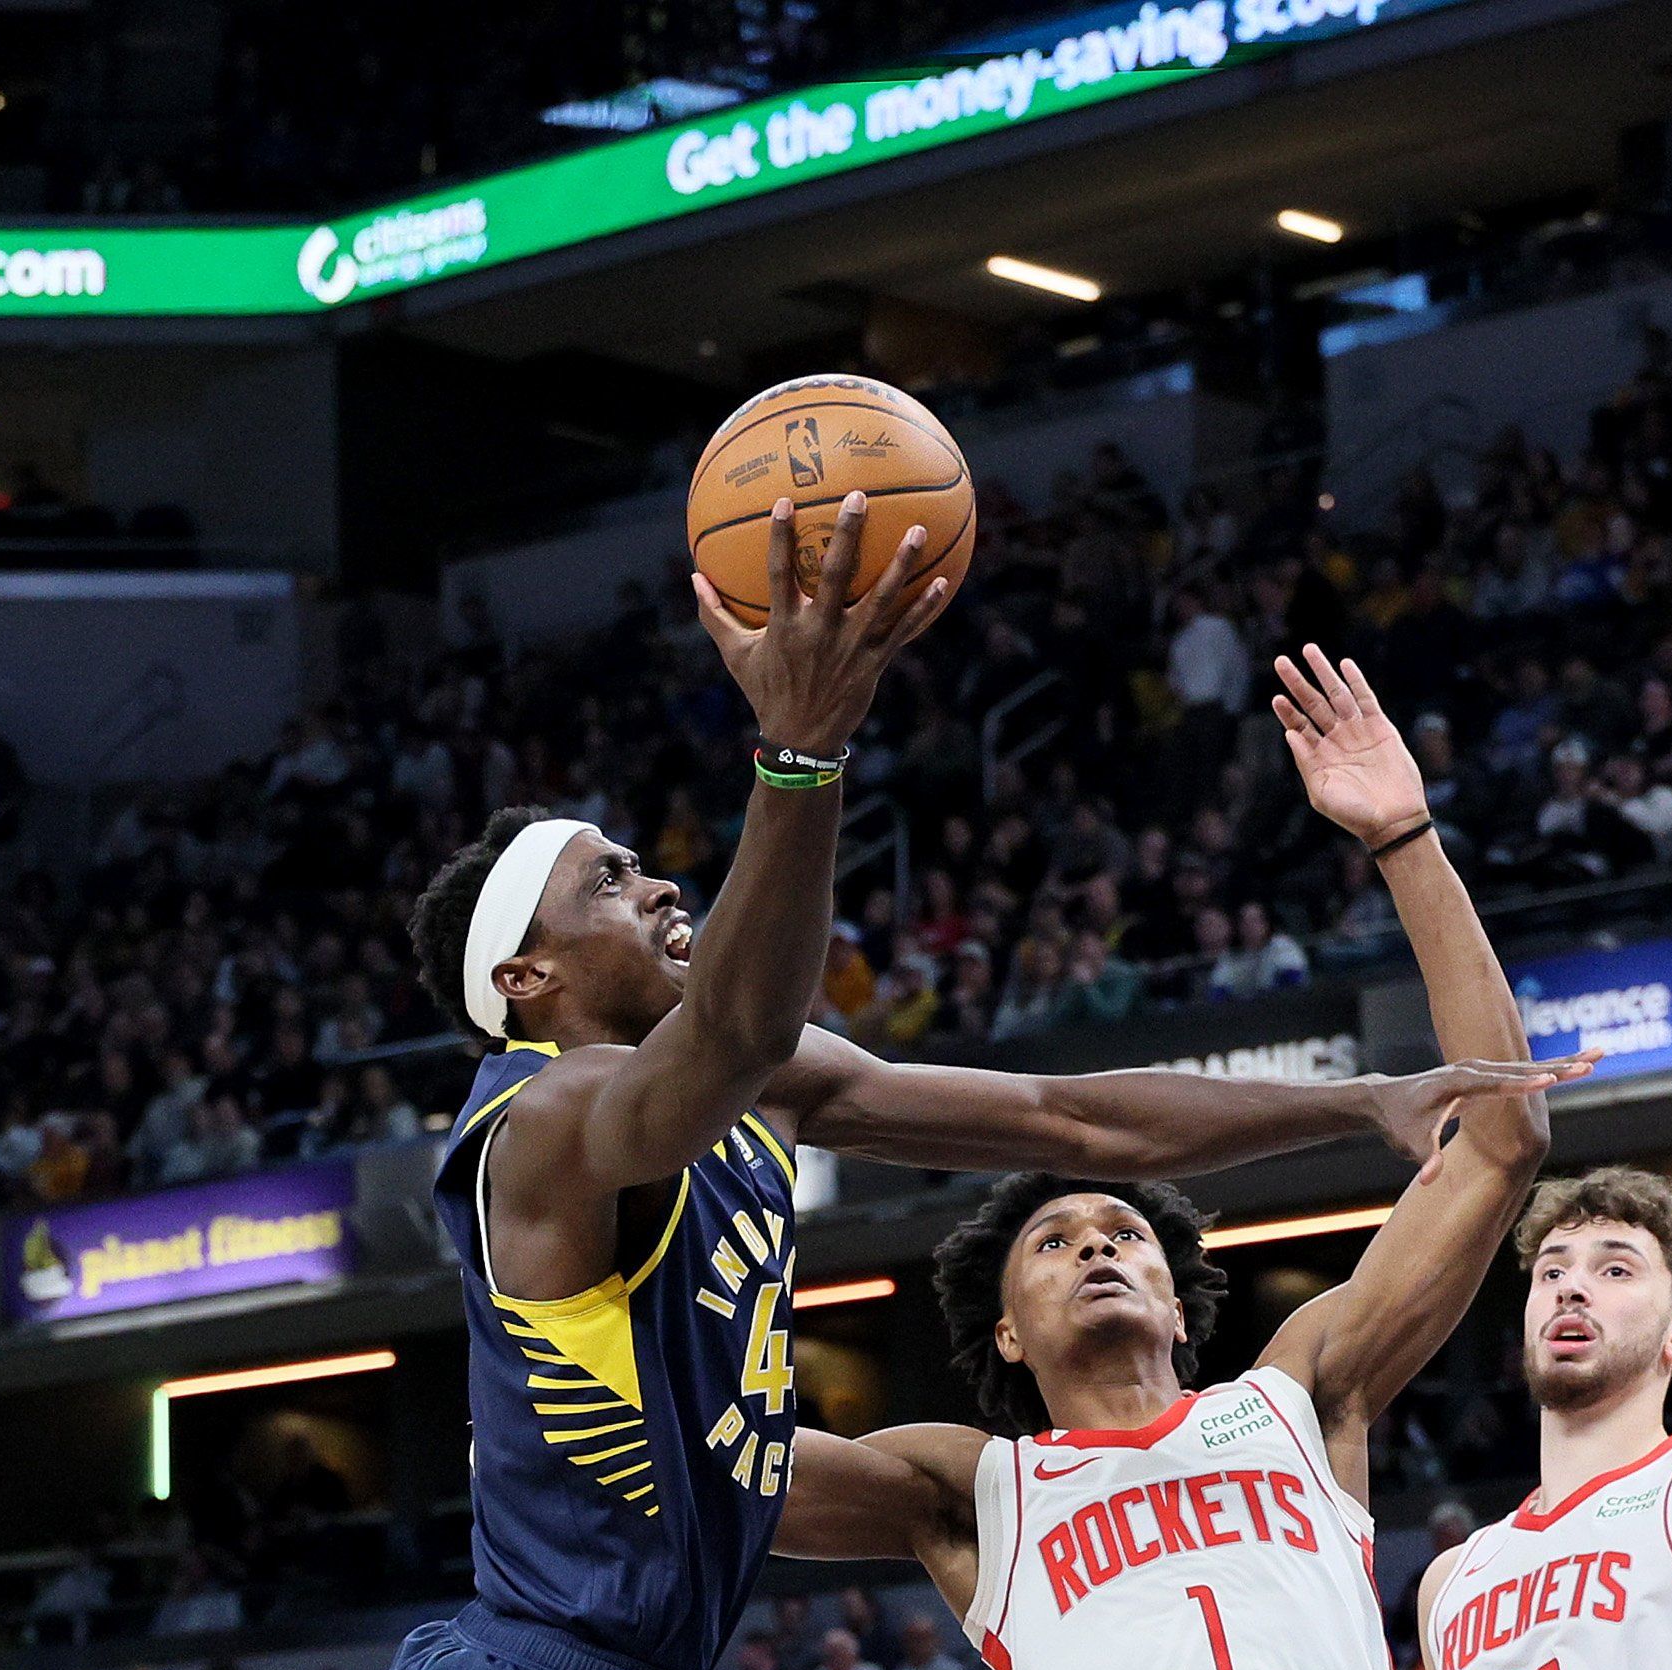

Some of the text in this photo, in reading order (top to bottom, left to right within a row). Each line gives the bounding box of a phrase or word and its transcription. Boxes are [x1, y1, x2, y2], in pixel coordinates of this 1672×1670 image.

[665, 115, 760, 195] Get
[768, 92, 856, 170] the
[866, 0, 1228, 141] money-saving
[77, 1208, 342, 1298] planet fitness
[740, 1282, 794, 1416] 4
[705, 1402, 794, 1497] PAC
[1199, 1396, 1266, 1431] credit
[1201, 1413, 1275, 1449] karma
[1595, 1498, 1657, 1519] karma
[1605, 1486, 1663, 1507] credit
[1038, 1469, 1320, 1617] ROCKETS
